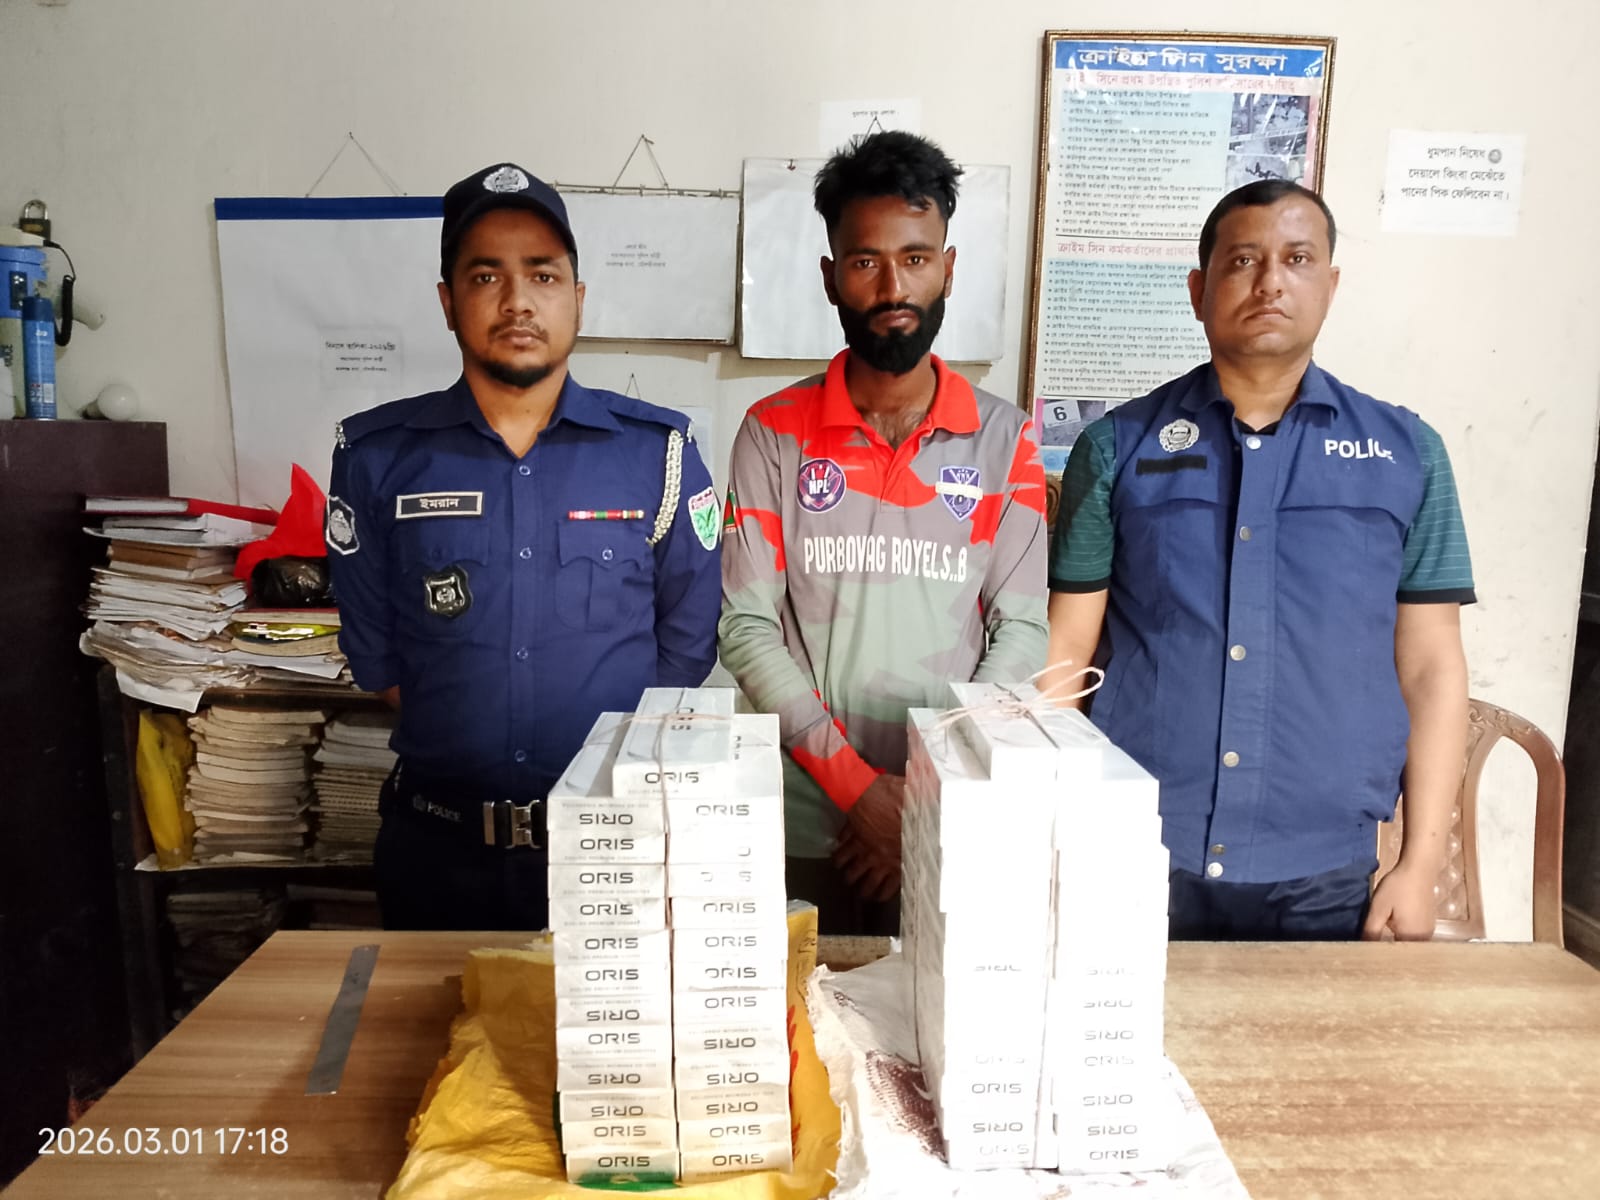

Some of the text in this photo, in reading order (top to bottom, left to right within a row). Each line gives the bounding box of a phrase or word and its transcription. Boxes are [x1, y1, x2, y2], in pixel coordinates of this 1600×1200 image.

[1215, 53, 1288, 73] সুরক্ষা
[1053, 406, 1068, 422] 6
[419, 498, 460, 509] ইমরান
[804, 535, 887, 575] PURBOVAG
[695, 803, 750, 817] ORIS
[579, 813, 634, 826] ORIS
[580, 838, 634, 851] ORIS
[579, 872, 634, 885] ORIS
[580, 903, 633, 916] ORIS
[703, 902, 757, 914] ORIS
[585, 937, 639, 950] ORIS
[705, 936, 757, 948] ORIS
[585, 968, 640, 982] ORIS
[705, 967, 757, 979] ORIS
[705, 996, 757, 1009] ORIS
[587, 1009, 641, 1022] ORIS
[588, 1033, 641, 1045] ORIS
[704, 1037, 757, 1050] ORIS
[588, 1073, 641, 1085] ORIS
[707, 1072, 760, 1086] ORIS
[971, 1083, 1022, 1095] ORIS
[591, 1105, 644, 1118] ORIS
[706, 1101, 759, 1115] ORIS
[594, 1125, 647, 1138] ORIS
[709, 1124, 762, 1139] ORIS
[972, 1122, 1023, 1134] ORIS
[712, 1153, 764, 1167] ORIS
[1089, 1149, 1139, 1161] ORIS
[598, 1156, 651, 1168] ORIS
